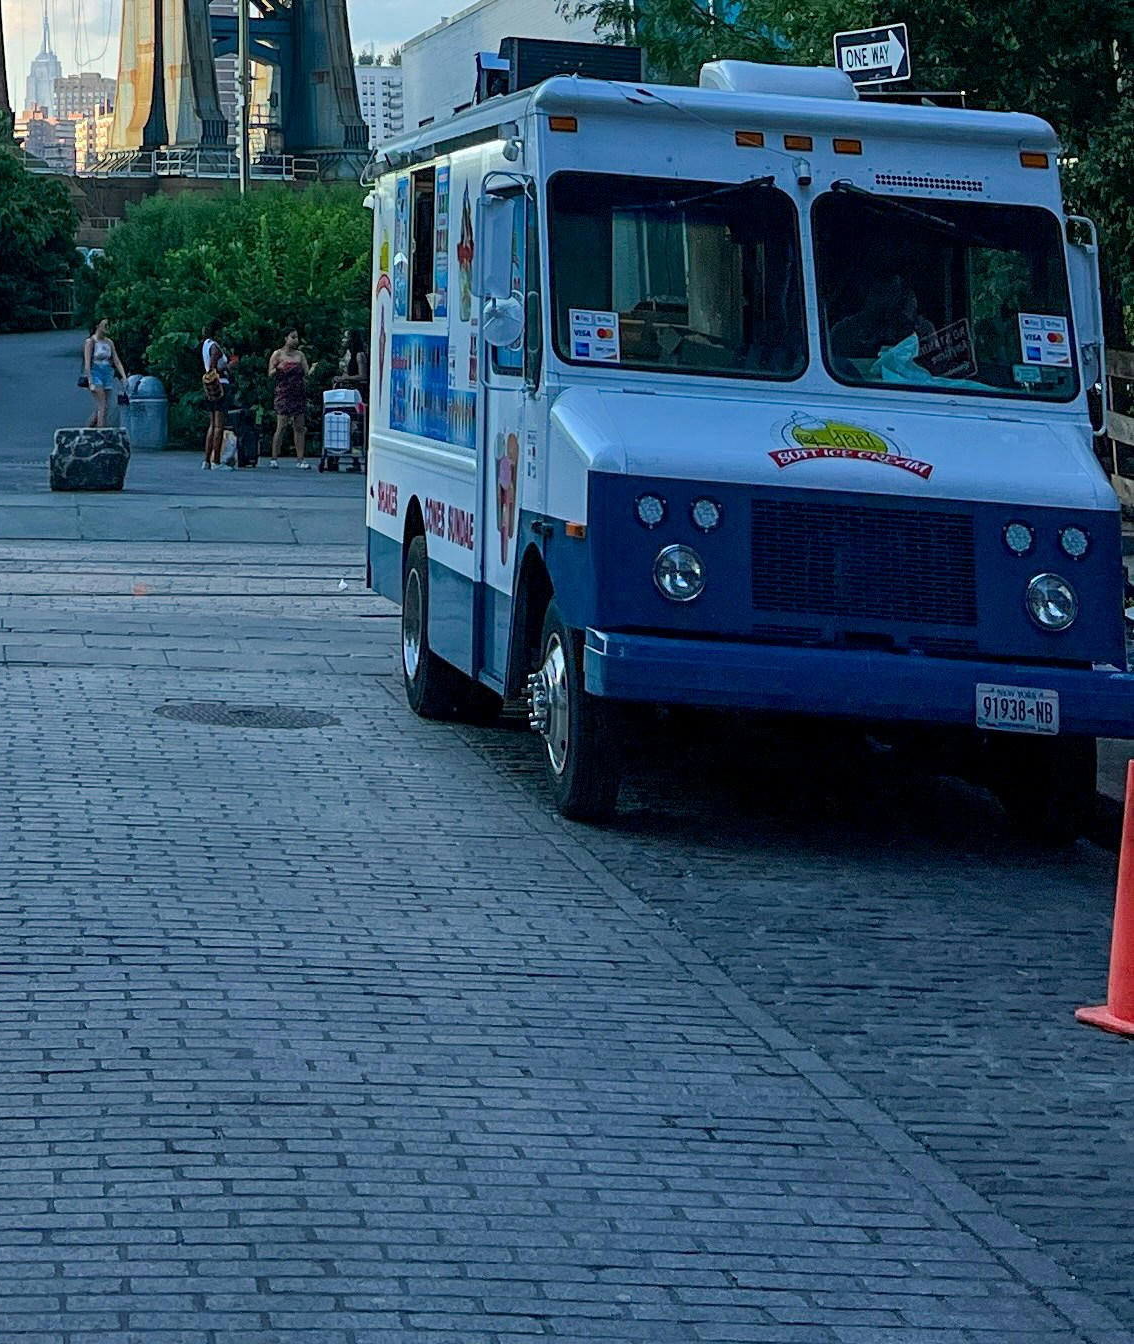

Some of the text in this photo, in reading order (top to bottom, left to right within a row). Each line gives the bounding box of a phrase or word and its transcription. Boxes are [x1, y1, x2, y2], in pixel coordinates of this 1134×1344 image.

[846, 44, 890, 68] ONE WAY
[573, 328, 592, 338] VISA
[1024, 333, 1042, 342] VISA
[777, 448, 930, 474] SOFT ICE CREAM
